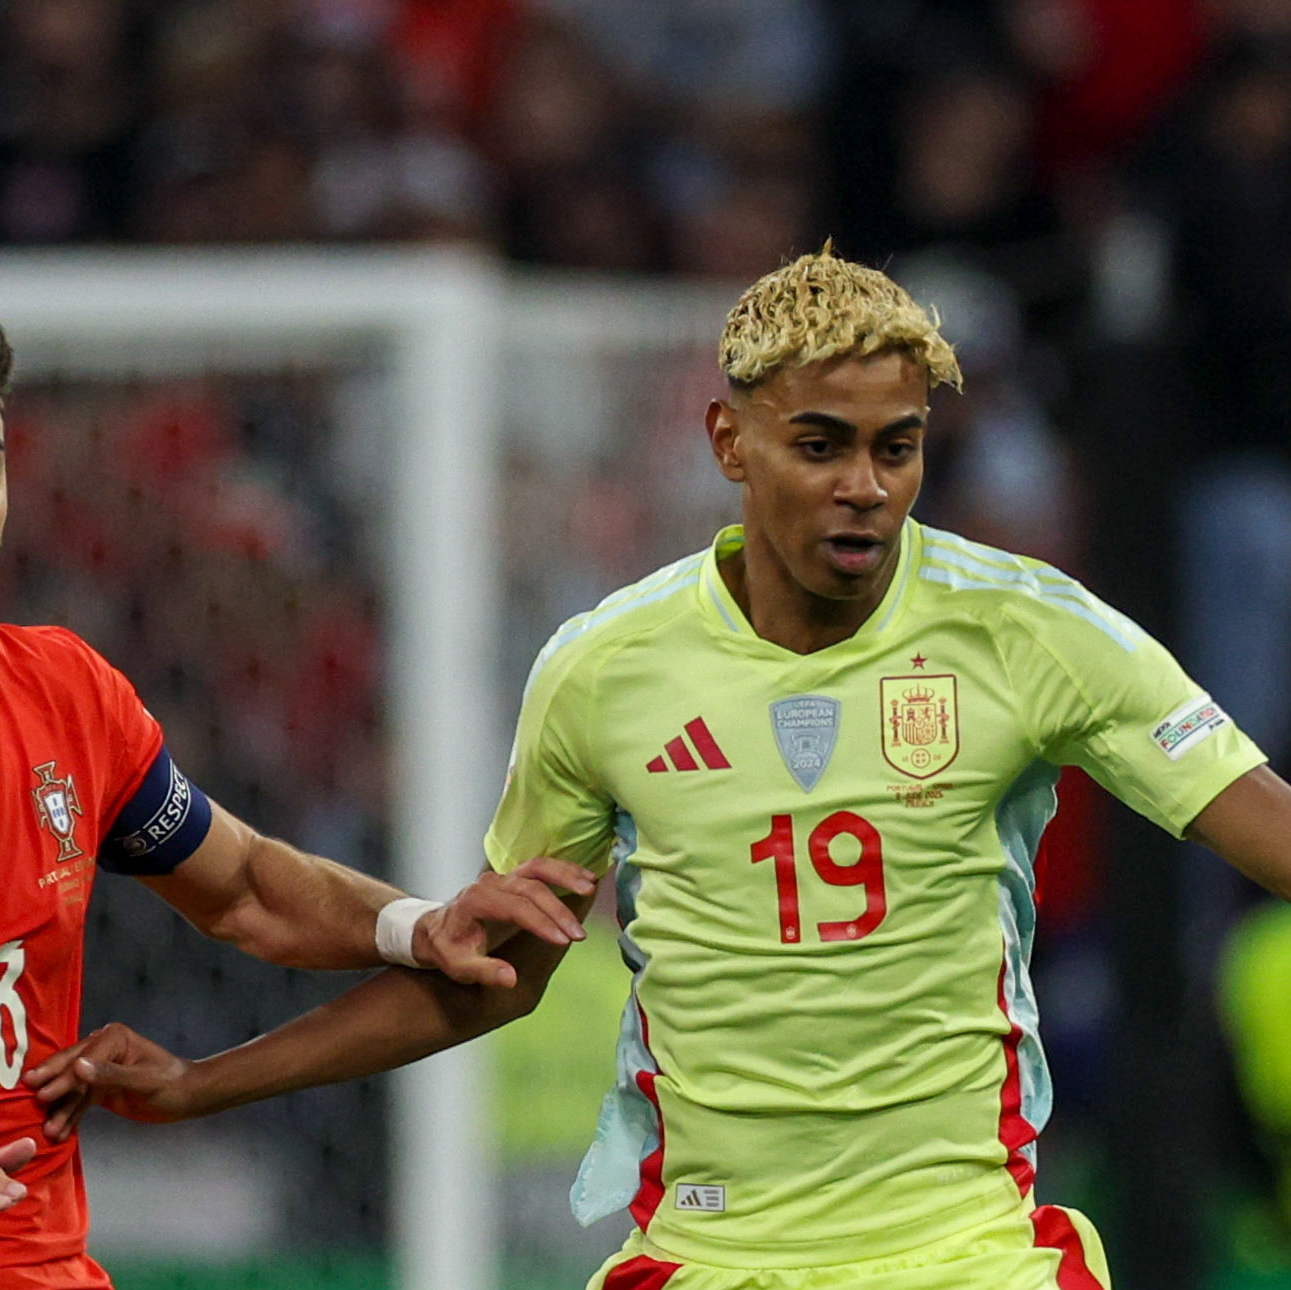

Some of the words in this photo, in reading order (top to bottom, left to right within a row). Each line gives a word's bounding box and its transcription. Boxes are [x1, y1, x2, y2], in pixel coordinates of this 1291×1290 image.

[777, 707, 834, 719] EUROPEAN
[777, 718, 834, 729] CHAMPIONS
[792, 759, 821, 769] 2024
[750, 810, 887, 944] 19
